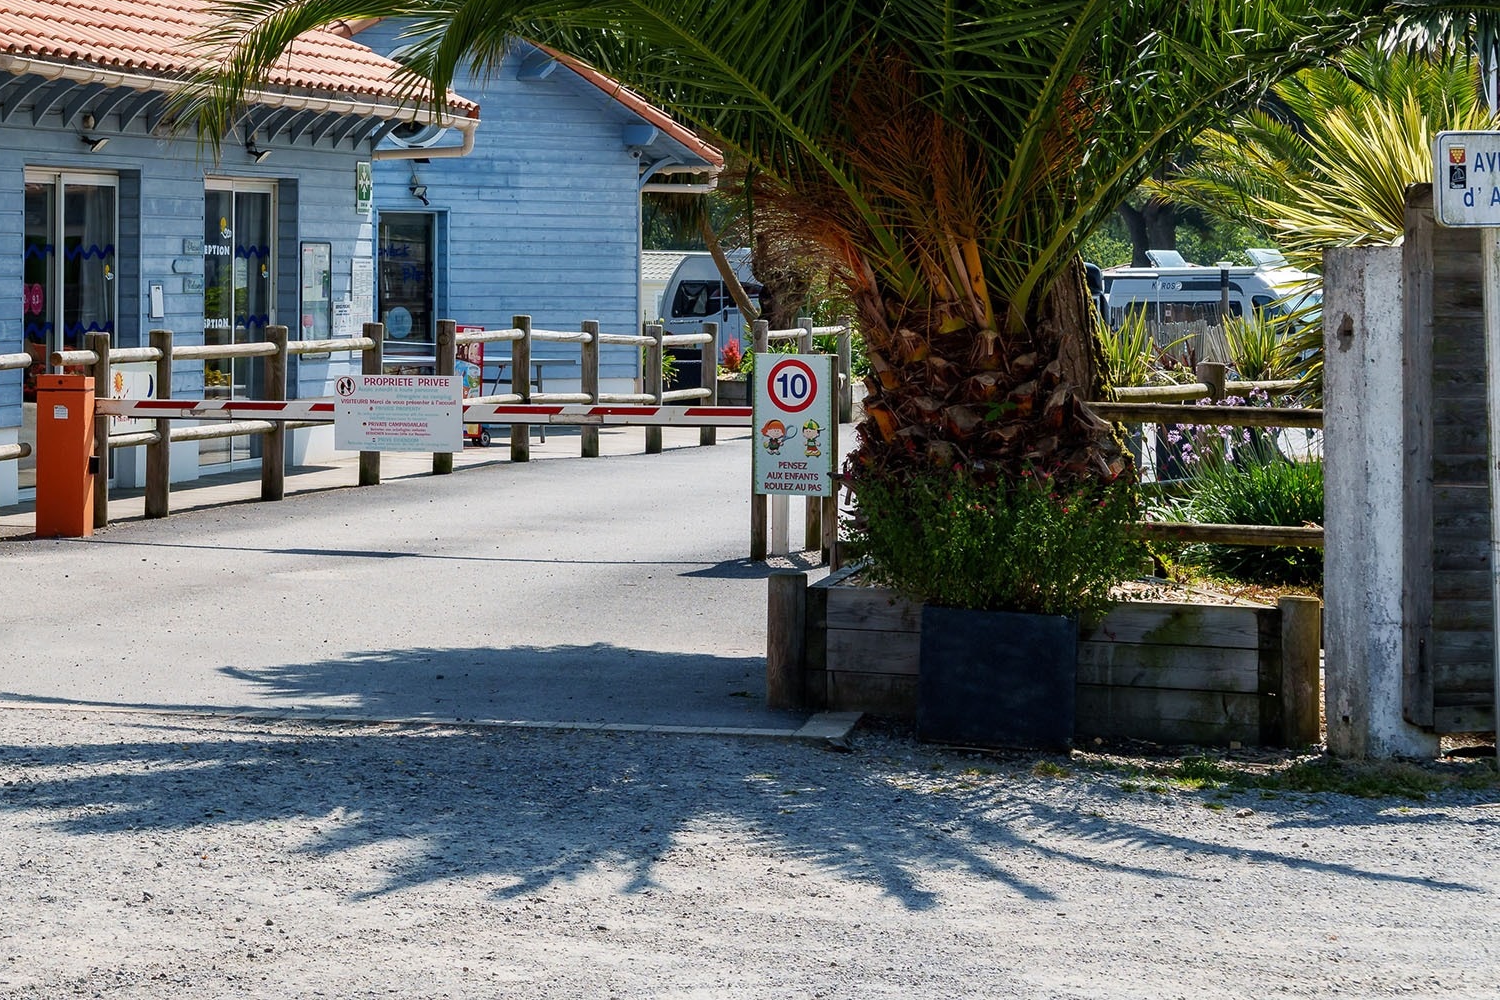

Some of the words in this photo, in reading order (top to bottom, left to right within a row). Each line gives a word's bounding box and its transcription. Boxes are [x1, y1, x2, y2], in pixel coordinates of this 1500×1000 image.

[1474, 152, 1500, 173] AV
[1151, 282, 1176, 290] KROS
[364, 378, 413, 386] PROPRIETE
[418, 378, 449, 387] PRIVEE
[777, 374, 808, 399] 10
[778, 461, 807, 469] PENSEZ
